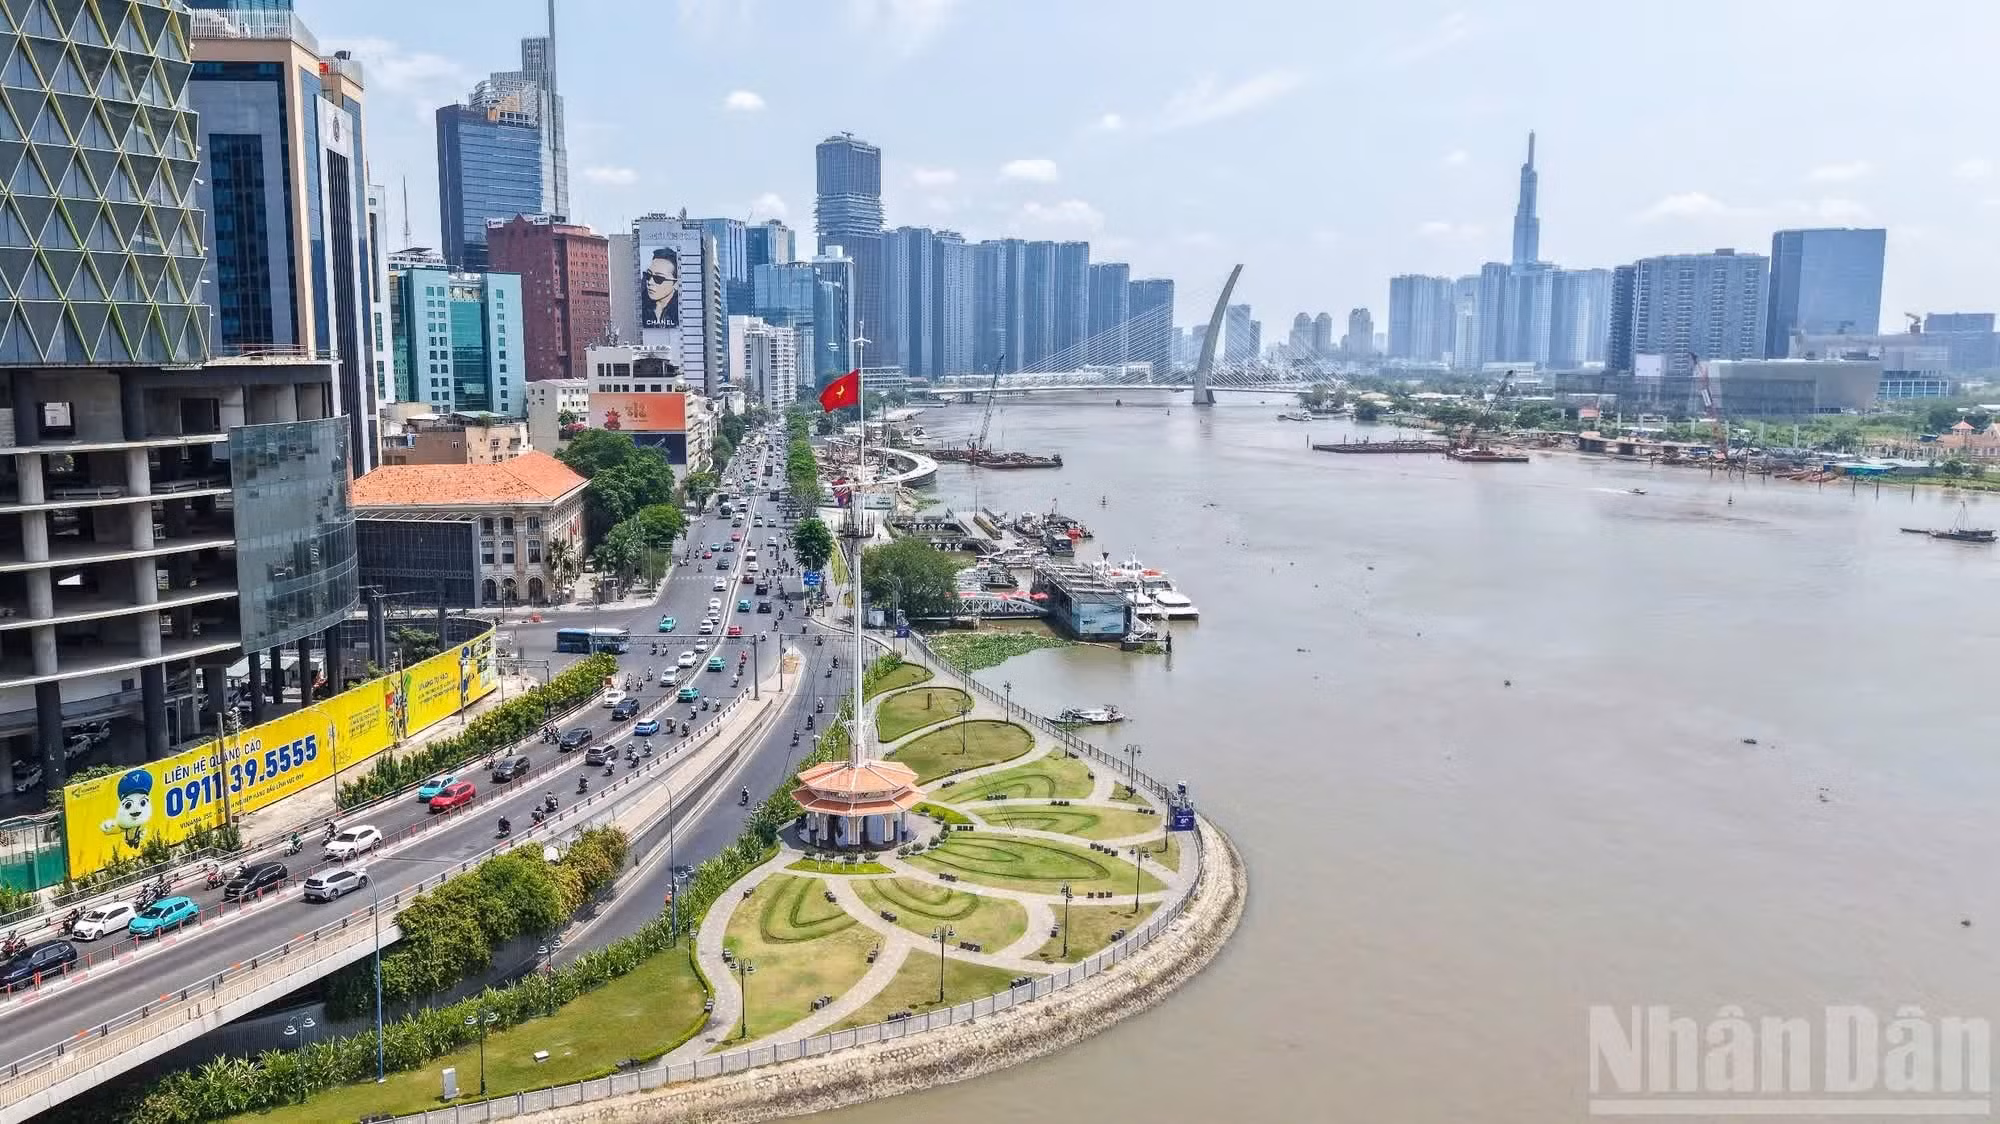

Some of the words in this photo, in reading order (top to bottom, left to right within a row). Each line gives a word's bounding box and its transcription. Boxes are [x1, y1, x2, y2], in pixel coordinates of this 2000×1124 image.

[165, 765, 190, 784] LIÊN
[193, 756, 206, 774] HỆ
[166, 734, 317, 817] 091139.5555
